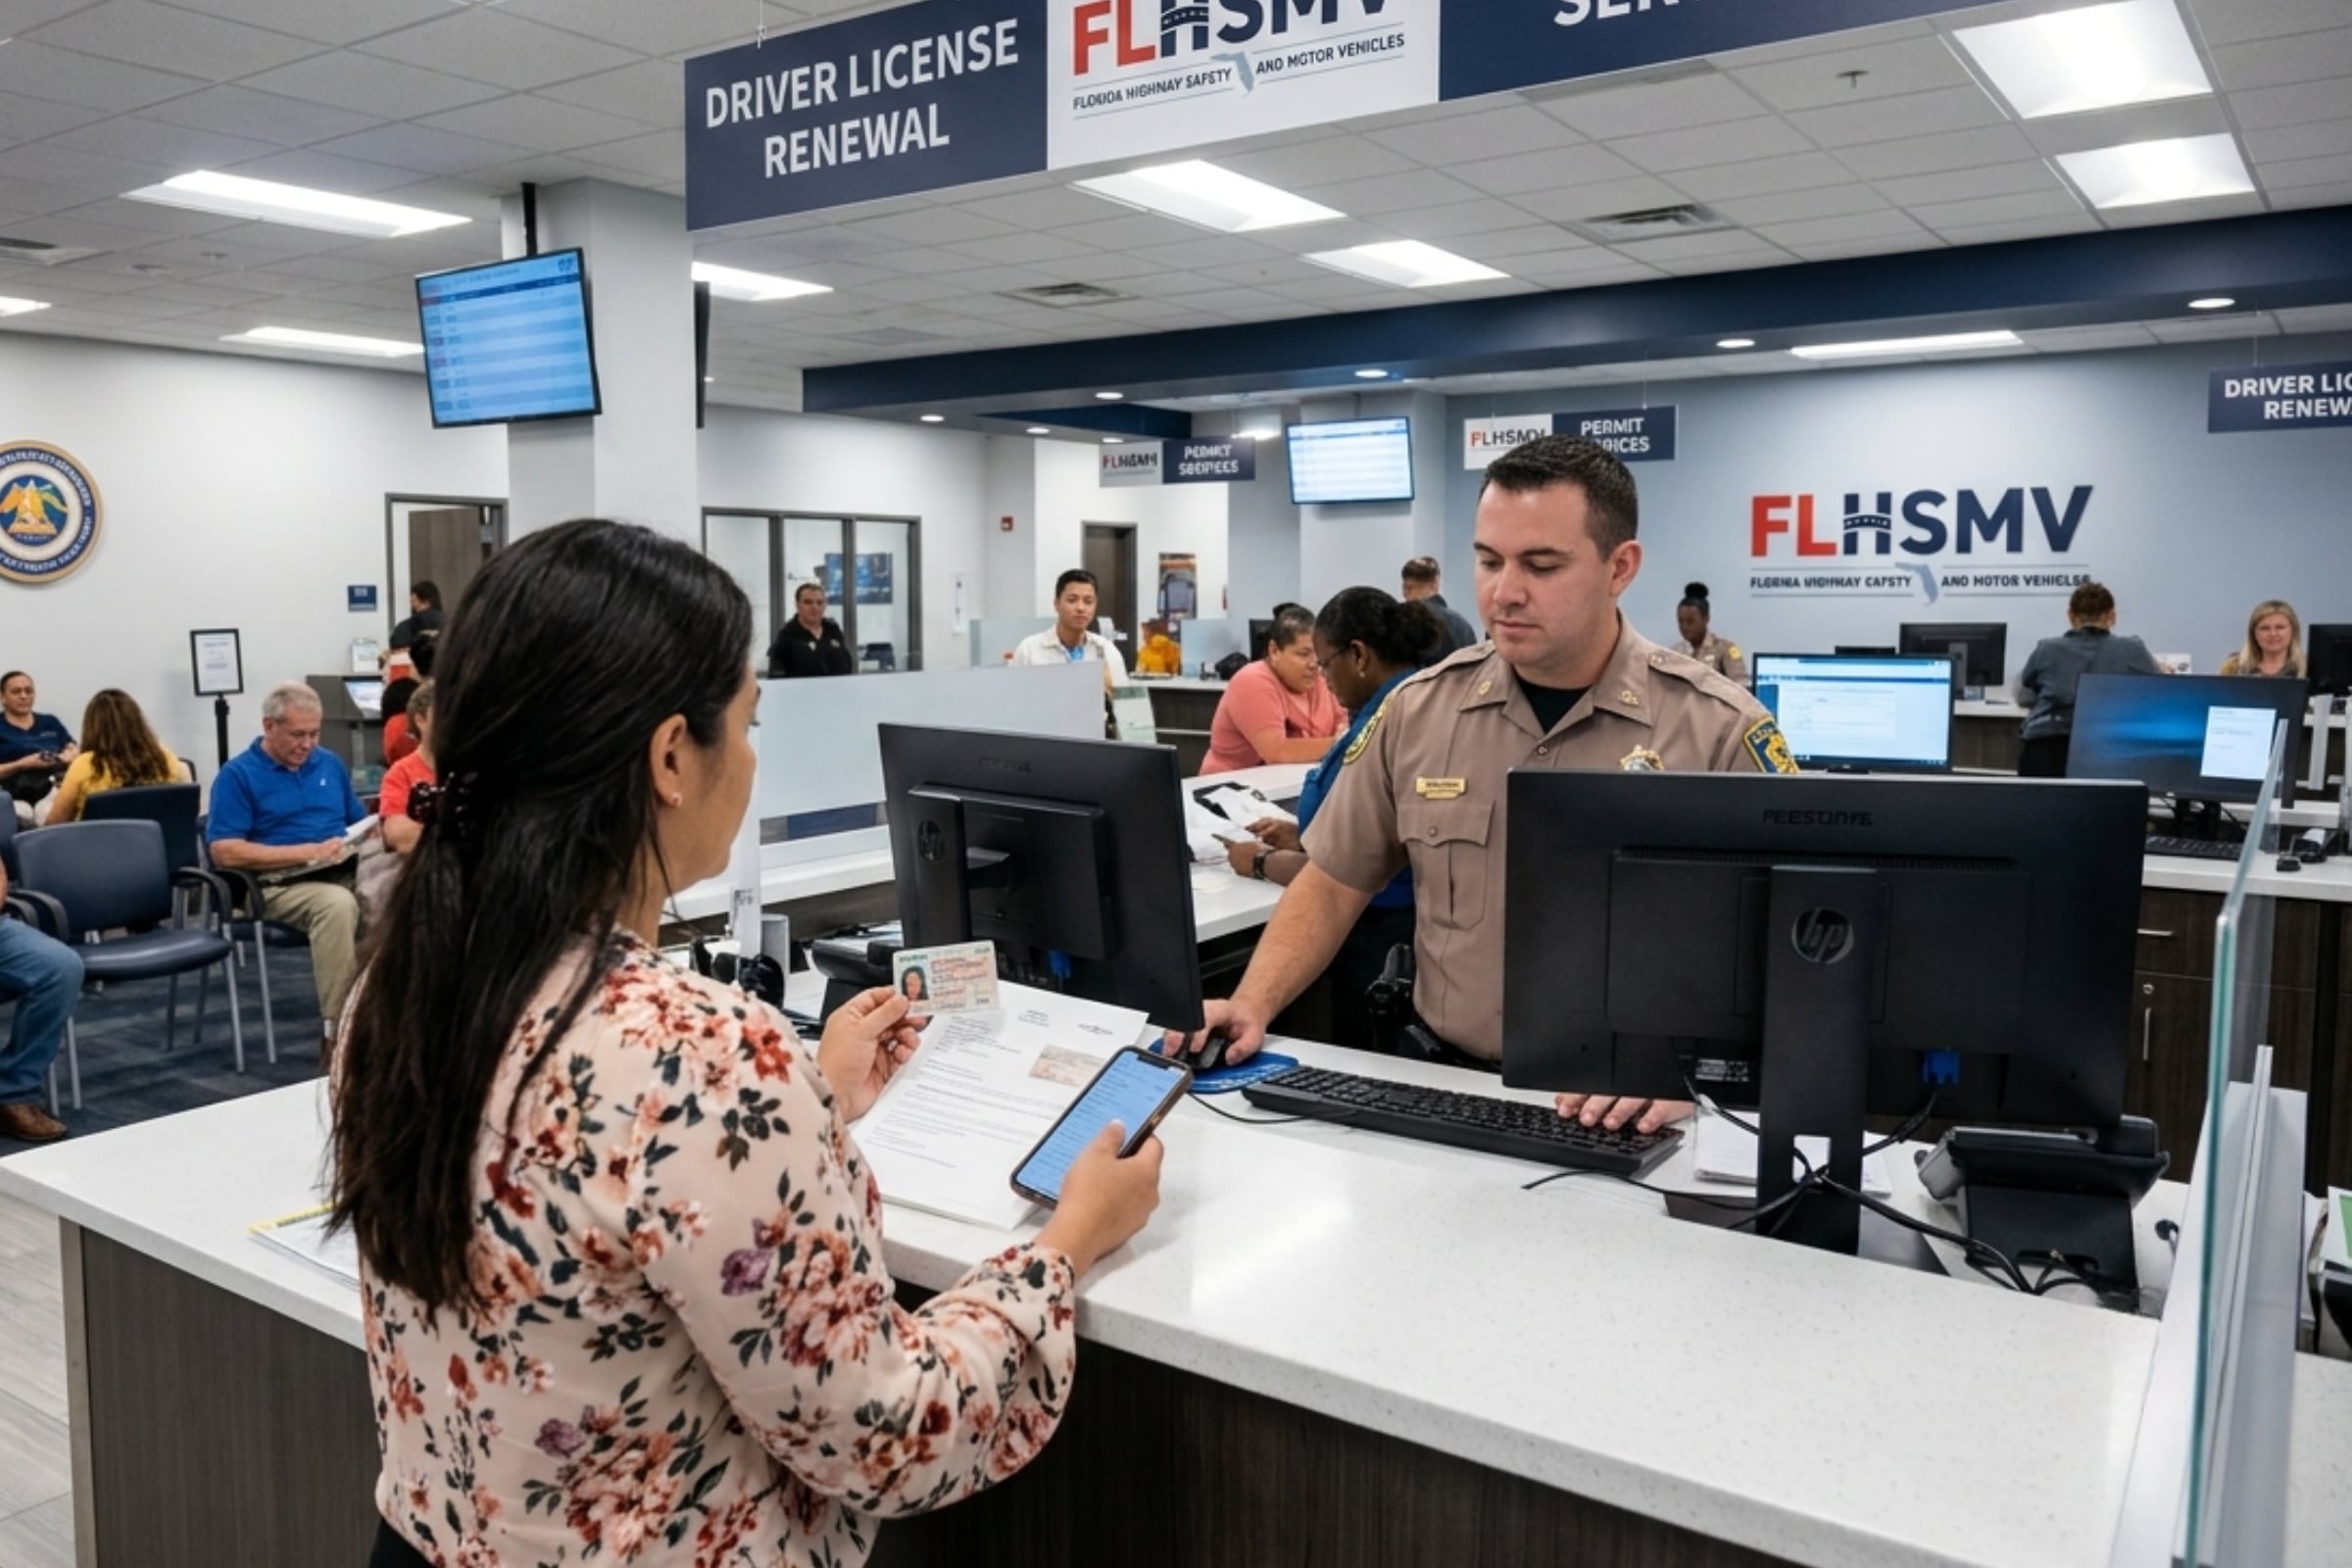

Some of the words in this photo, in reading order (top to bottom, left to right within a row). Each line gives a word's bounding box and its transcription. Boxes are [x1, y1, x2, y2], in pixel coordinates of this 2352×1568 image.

[706, 61, 839, 128] DRIVER
[850, 18, 1019, 97] LICENSE
[1074, 0, 1386, 75] FLHS
[1337, 32, 1404, 58] VEHICLES
[764, 102, 950, 178] RENEWAL
[2224, 374, 2315, 399] DRIVER
[2264, 396, 2352, 419] RENEW
[1750, 484, 2094, 558] FLHSMV
